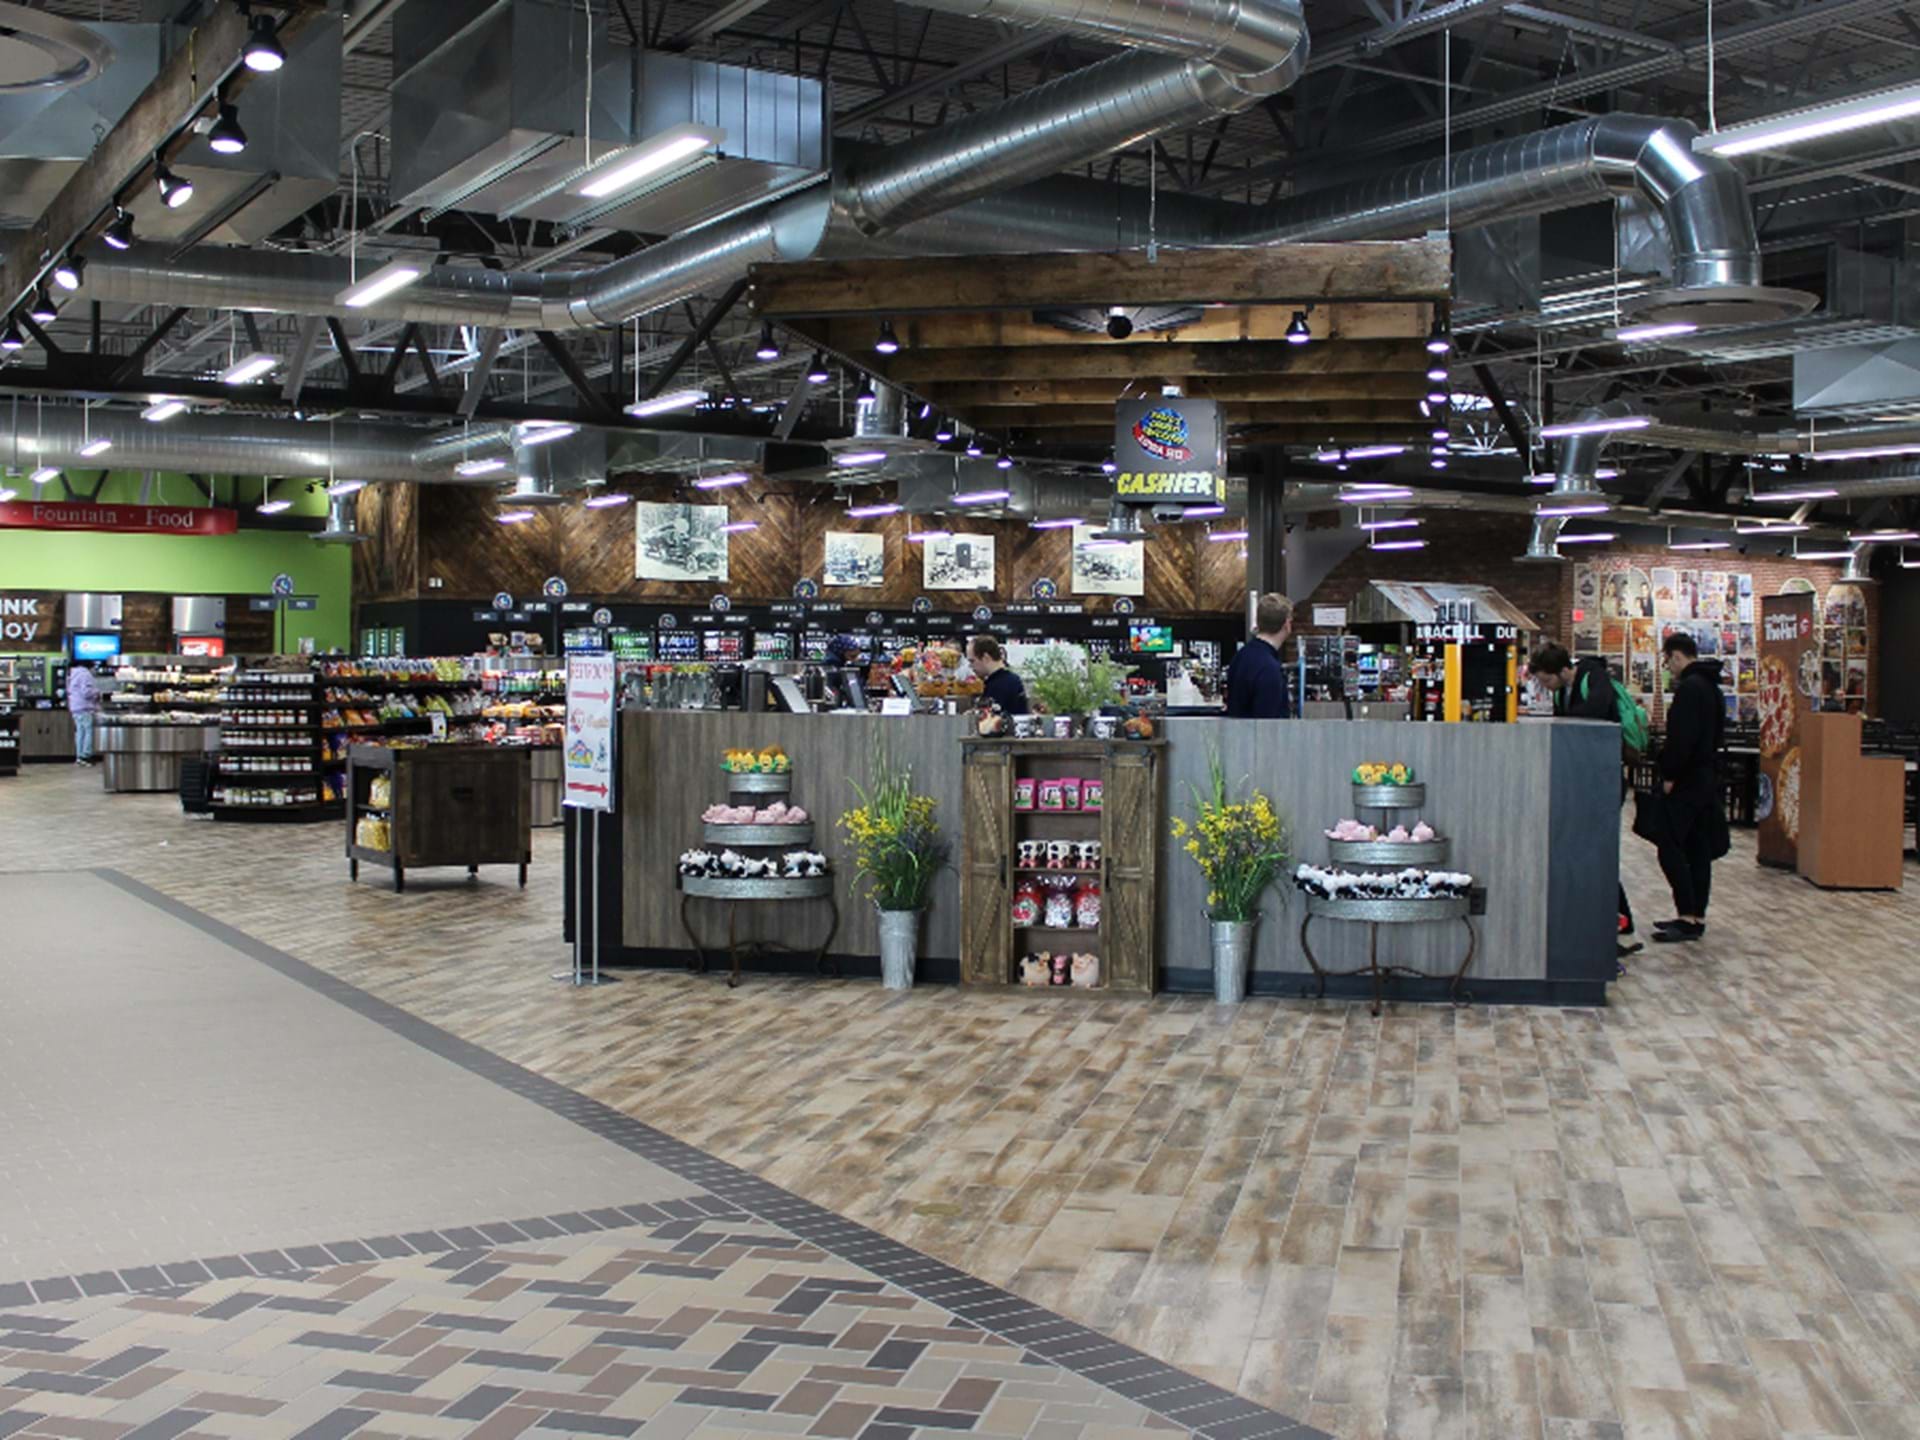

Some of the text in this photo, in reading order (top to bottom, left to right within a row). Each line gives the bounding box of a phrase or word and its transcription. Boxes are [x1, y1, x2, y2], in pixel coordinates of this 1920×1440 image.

[1117, 471, 1213, 495] CASHIER
[32, 504, 194, 528] Fountain Food
